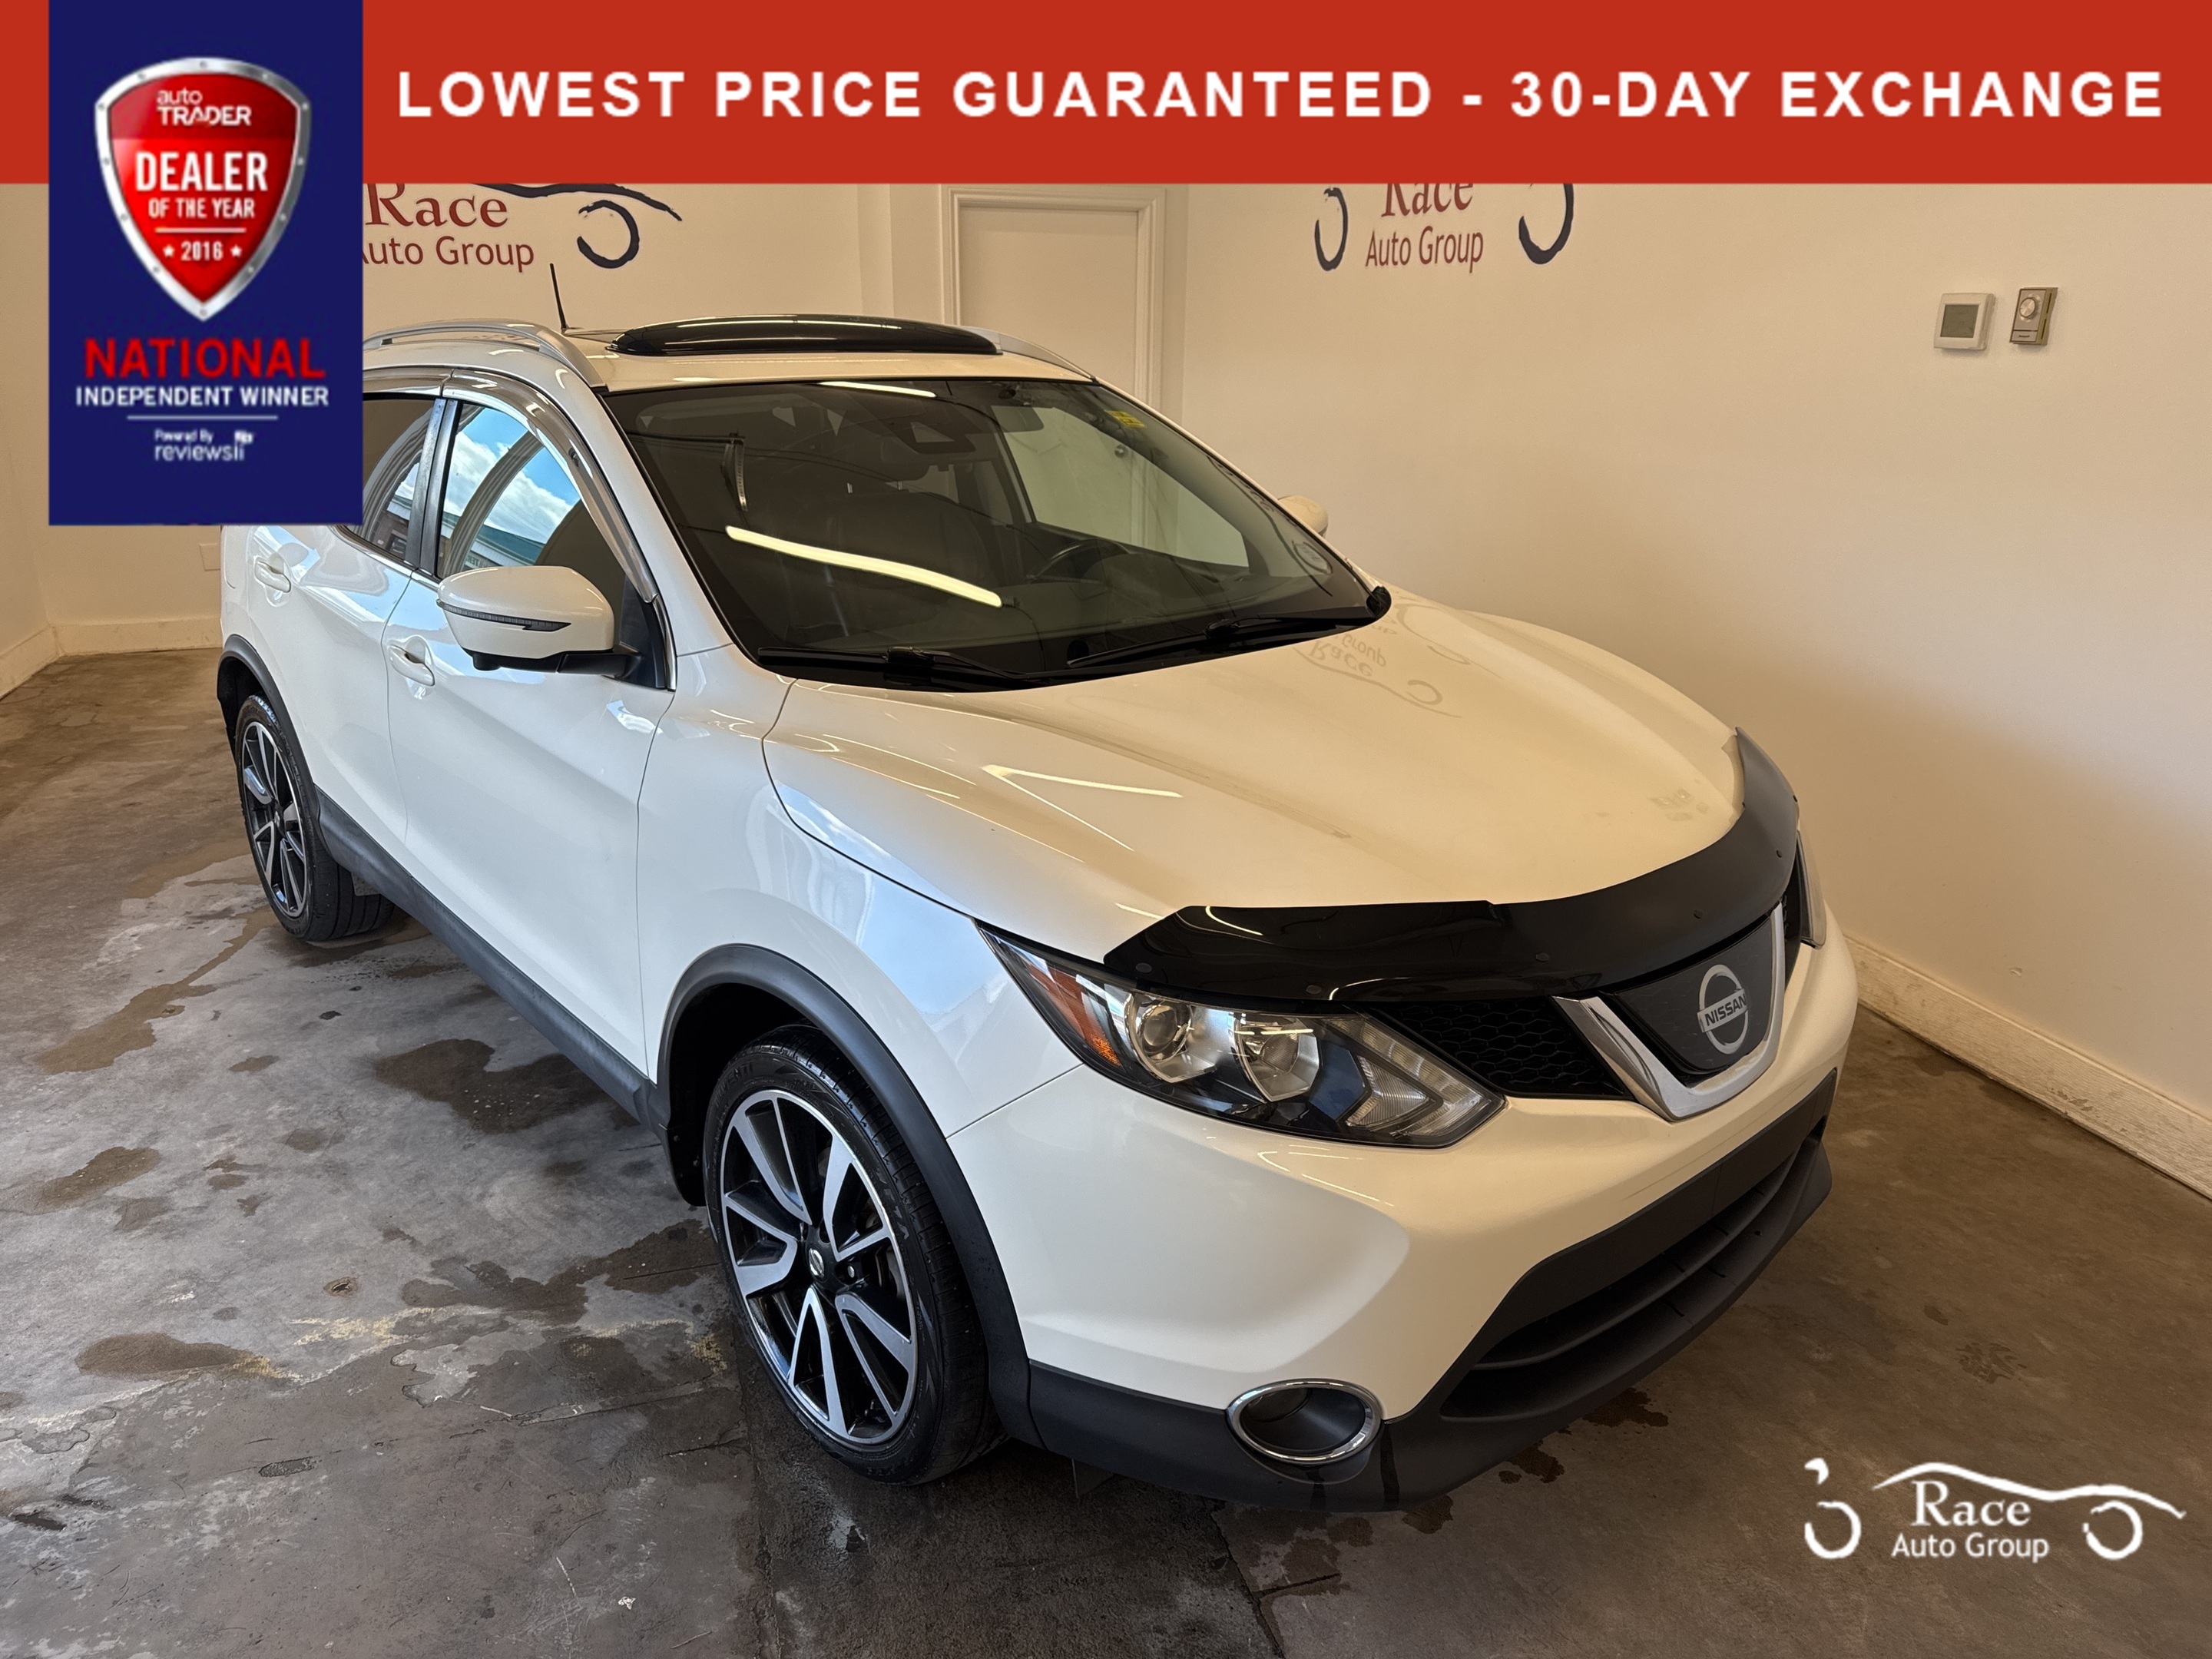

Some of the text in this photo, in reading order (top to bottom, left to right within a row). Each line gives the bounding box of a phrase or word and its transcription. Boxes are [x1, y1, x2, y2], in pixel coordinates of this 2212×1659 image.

[365, 184, 508, 228] Race
[435, 235, 535, 273] Group
[1365, 225, 1484, 273] Auto Group
[1704, 993, 1747, 1027] NISSAN
